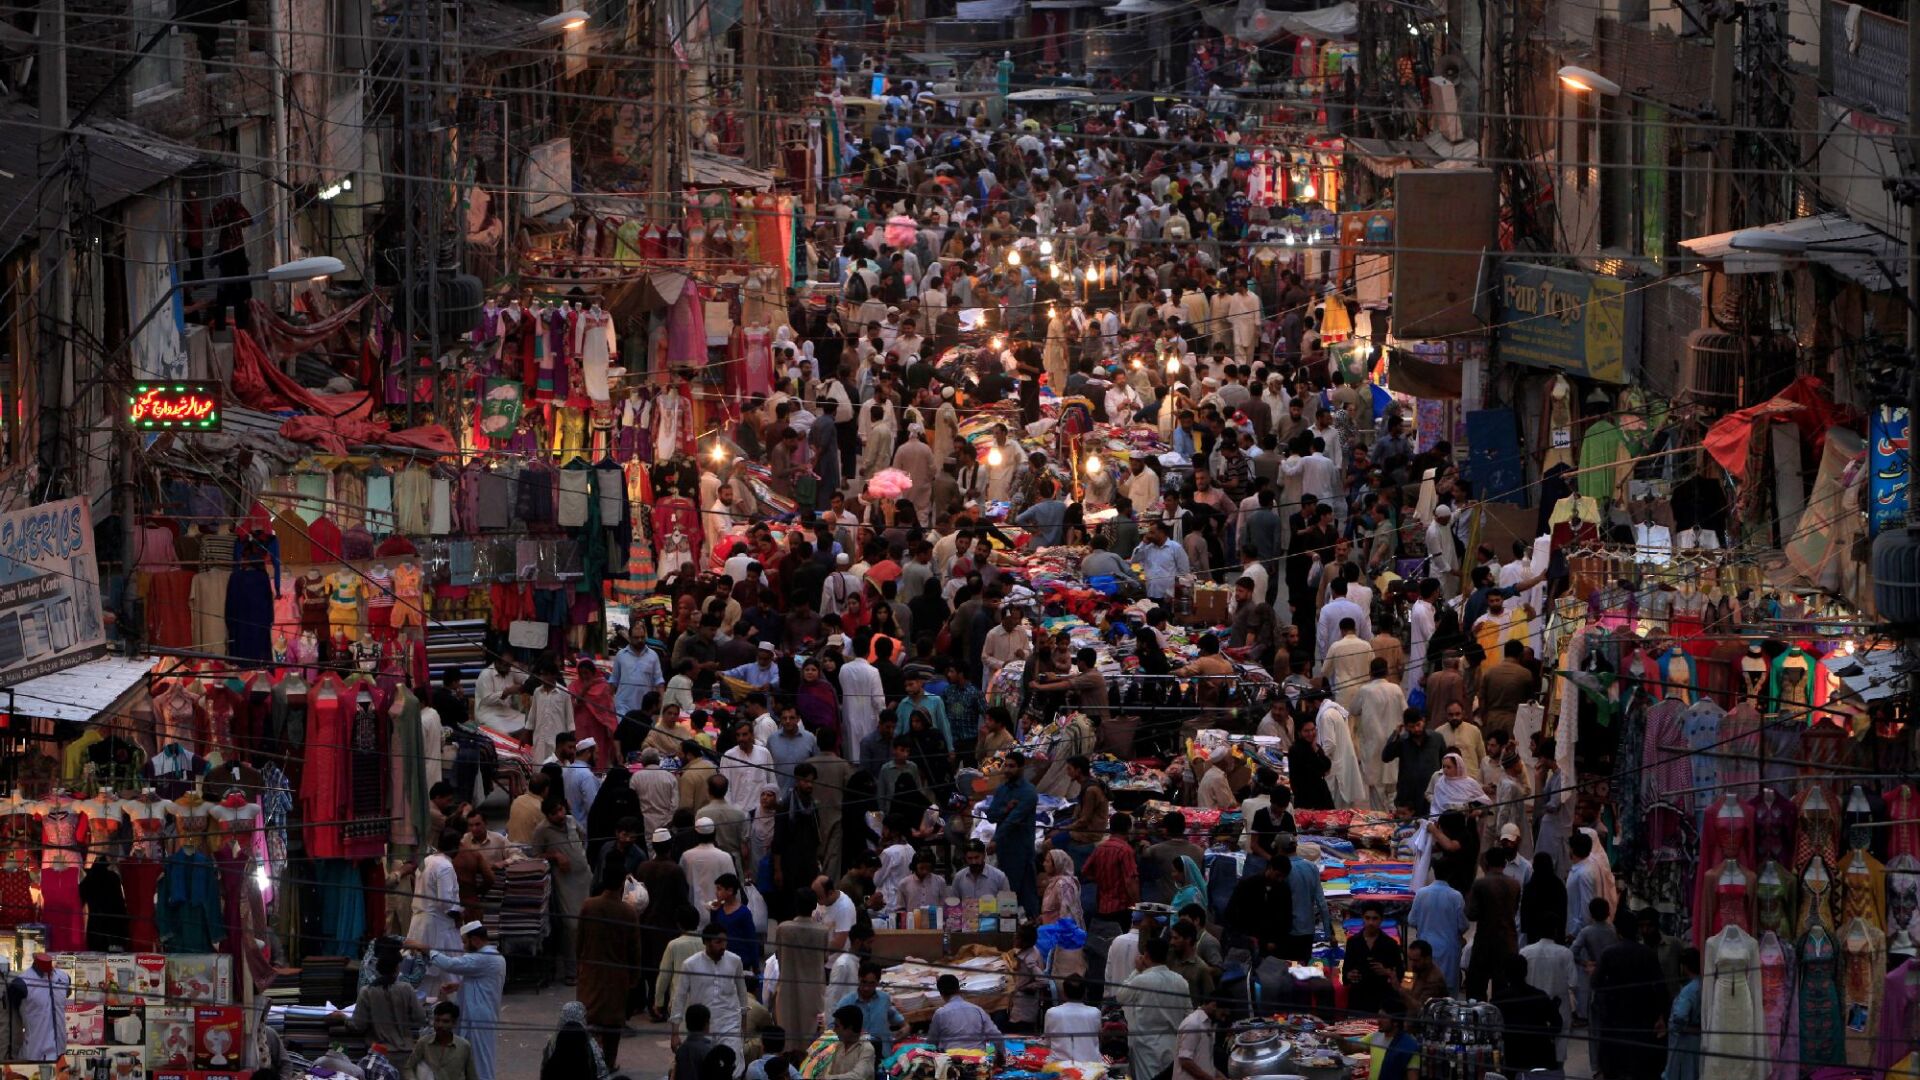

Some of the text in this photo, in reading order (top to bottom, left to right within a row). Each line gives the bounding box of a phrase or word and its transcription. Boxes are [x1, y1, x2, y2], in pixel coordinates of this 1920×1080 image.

[2, 504, 82, 575] FABRICS
[17, 581, 40, 600] Variety
[66, 1048, 101, 1056] EURON
